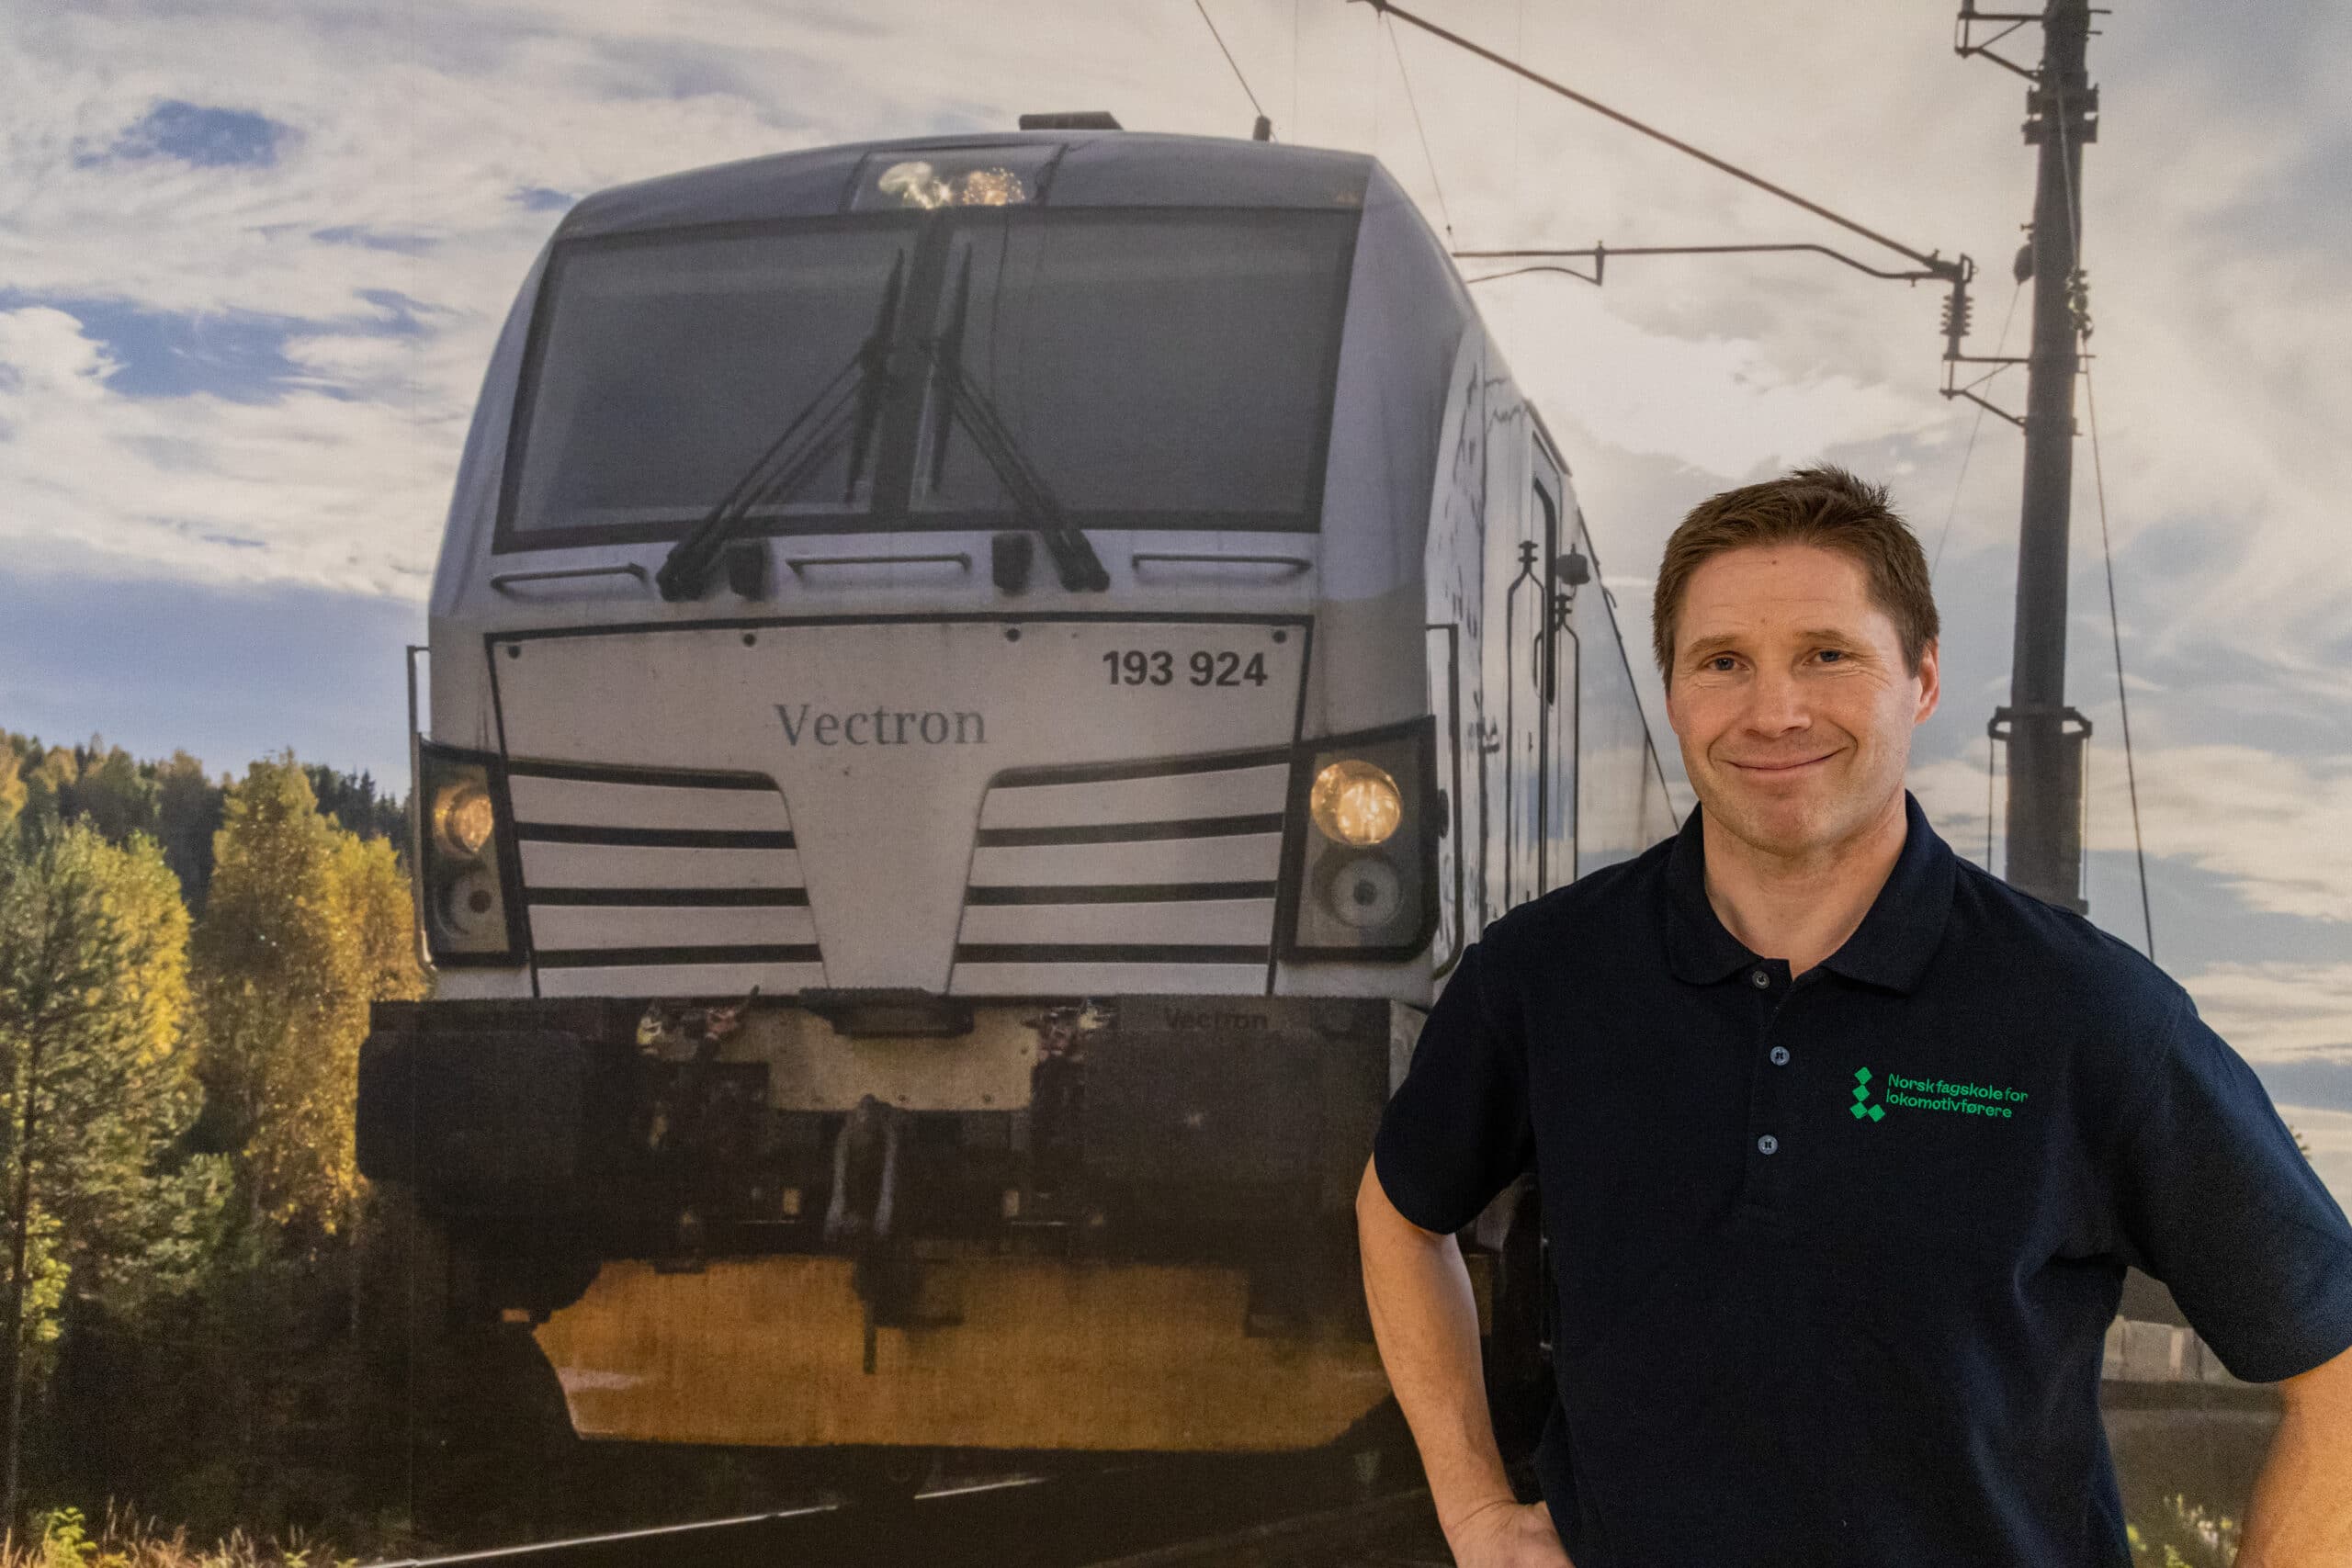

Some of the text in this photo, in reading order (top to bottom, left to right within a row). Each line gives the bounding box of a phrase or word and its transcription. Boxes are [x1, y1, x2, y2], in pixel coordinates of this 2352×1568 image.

[1103, 650, 1268, 686] 193 924
[775, 704, 986, 746] Vectron
[1885, 1089, 2013, 1118] lokomotivførere
[1888, 1073, 2029, 1102] Norsk fagskole for
